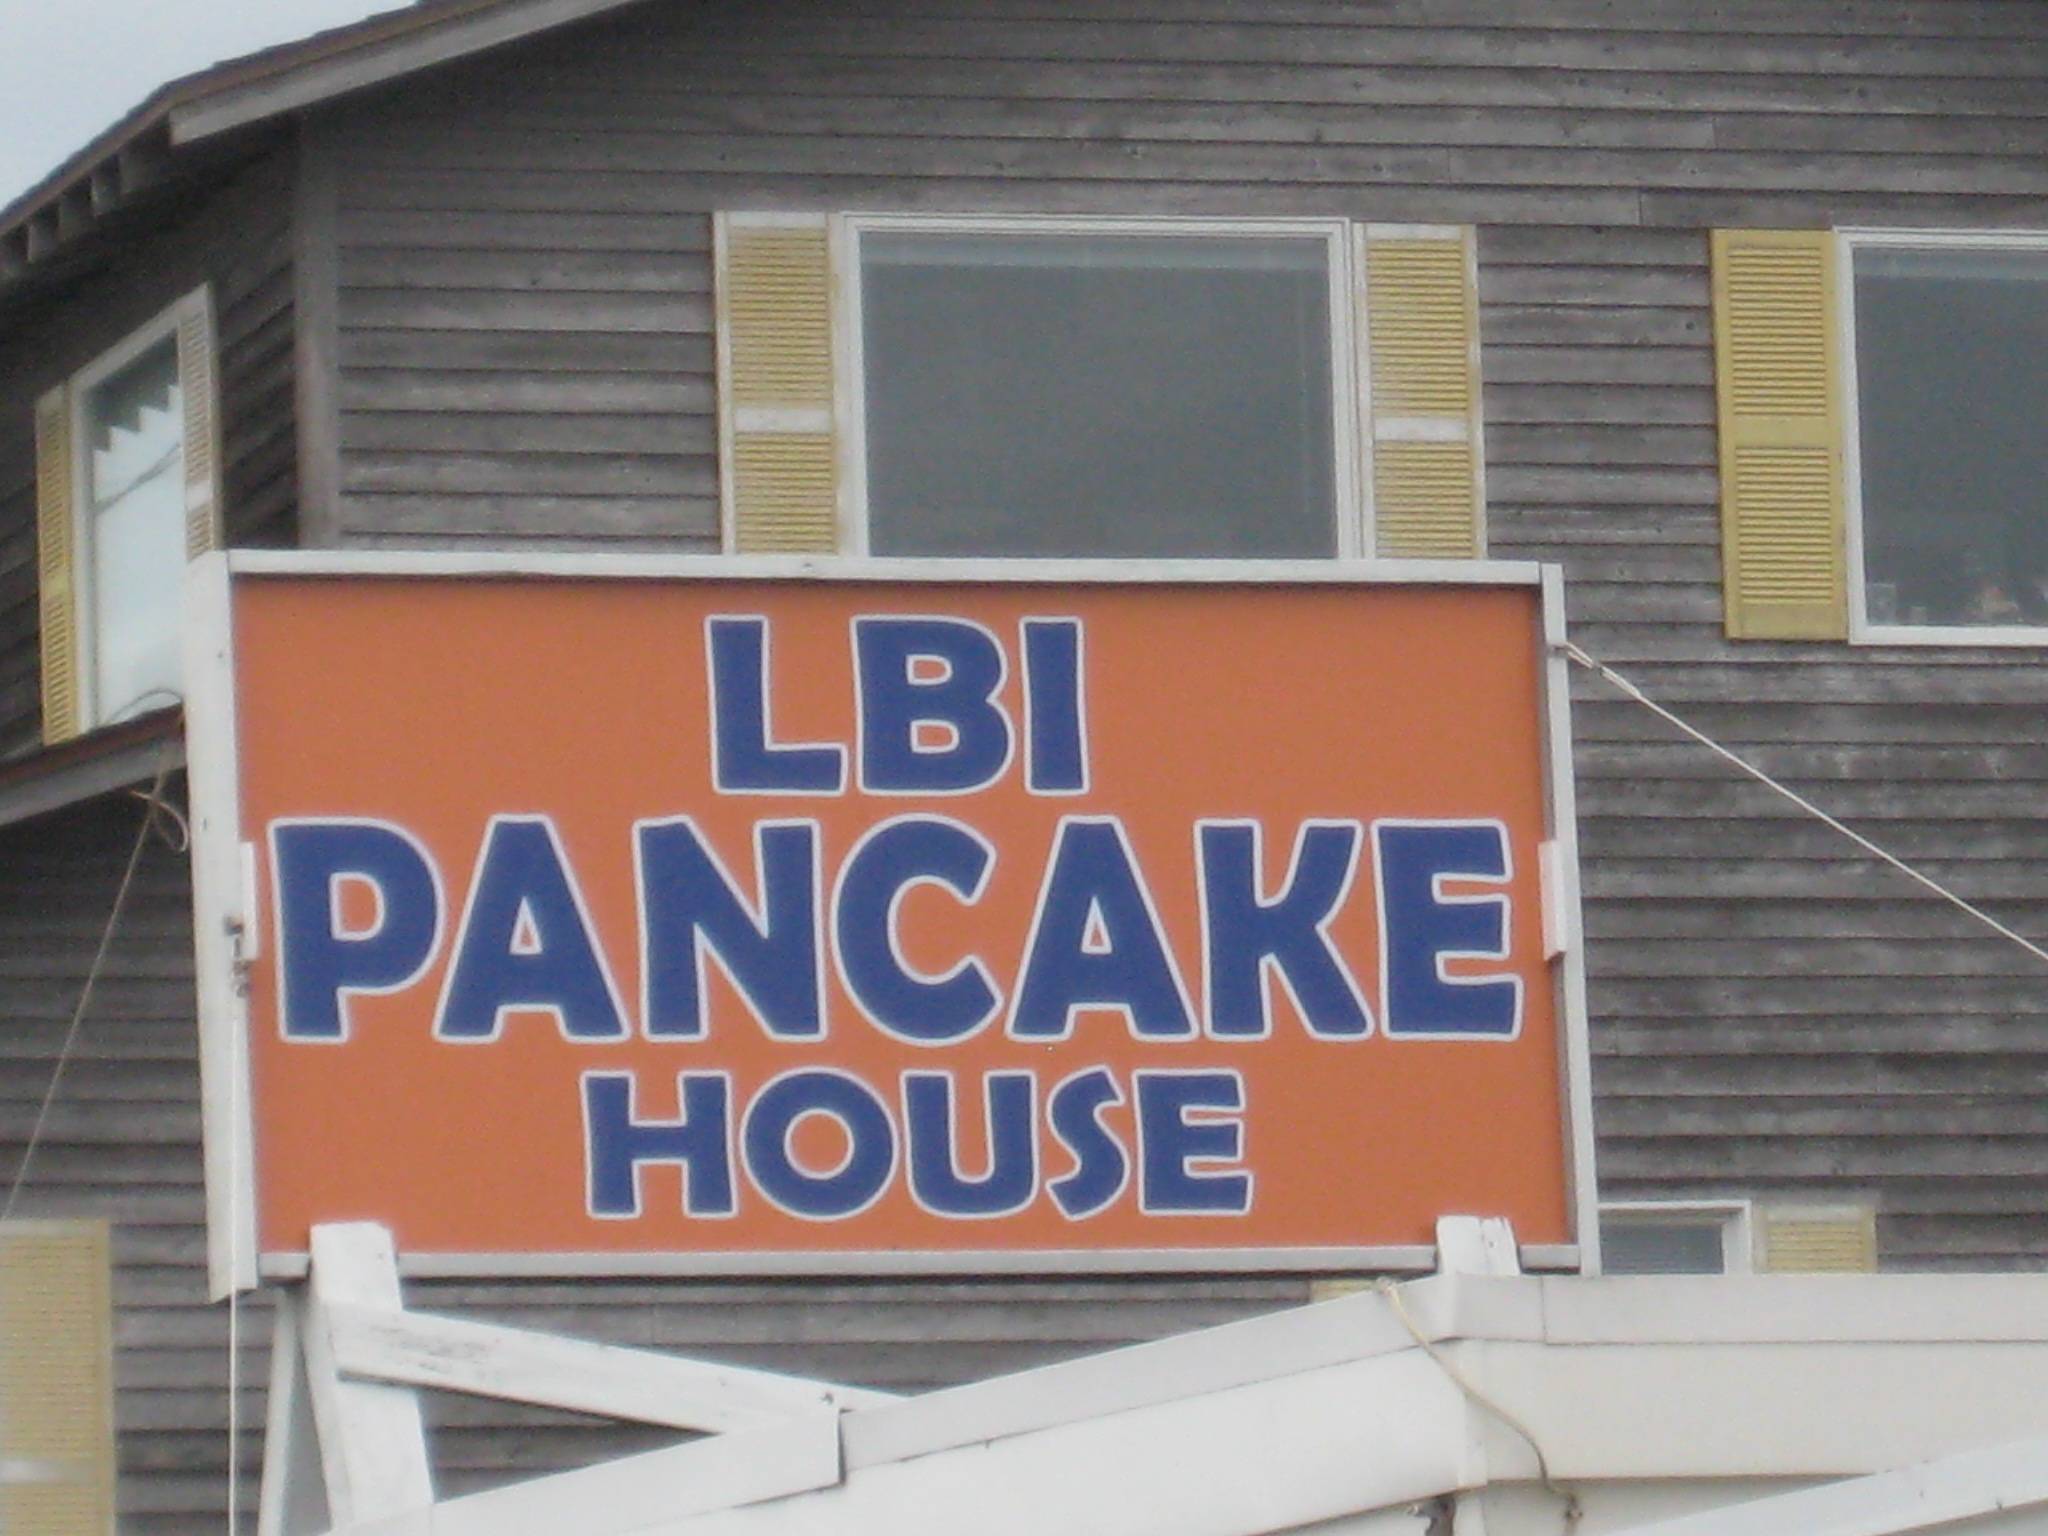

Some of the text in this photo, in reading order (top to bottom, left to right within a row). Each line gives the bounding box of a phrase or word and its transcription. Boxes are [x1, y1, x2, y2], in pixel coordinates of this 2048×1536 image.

[703, 612, 1092, 798] LBI
[267, 812, 1526, 1047] PANCAKE
[579, 1064, 1256, 1224] HOUSE
